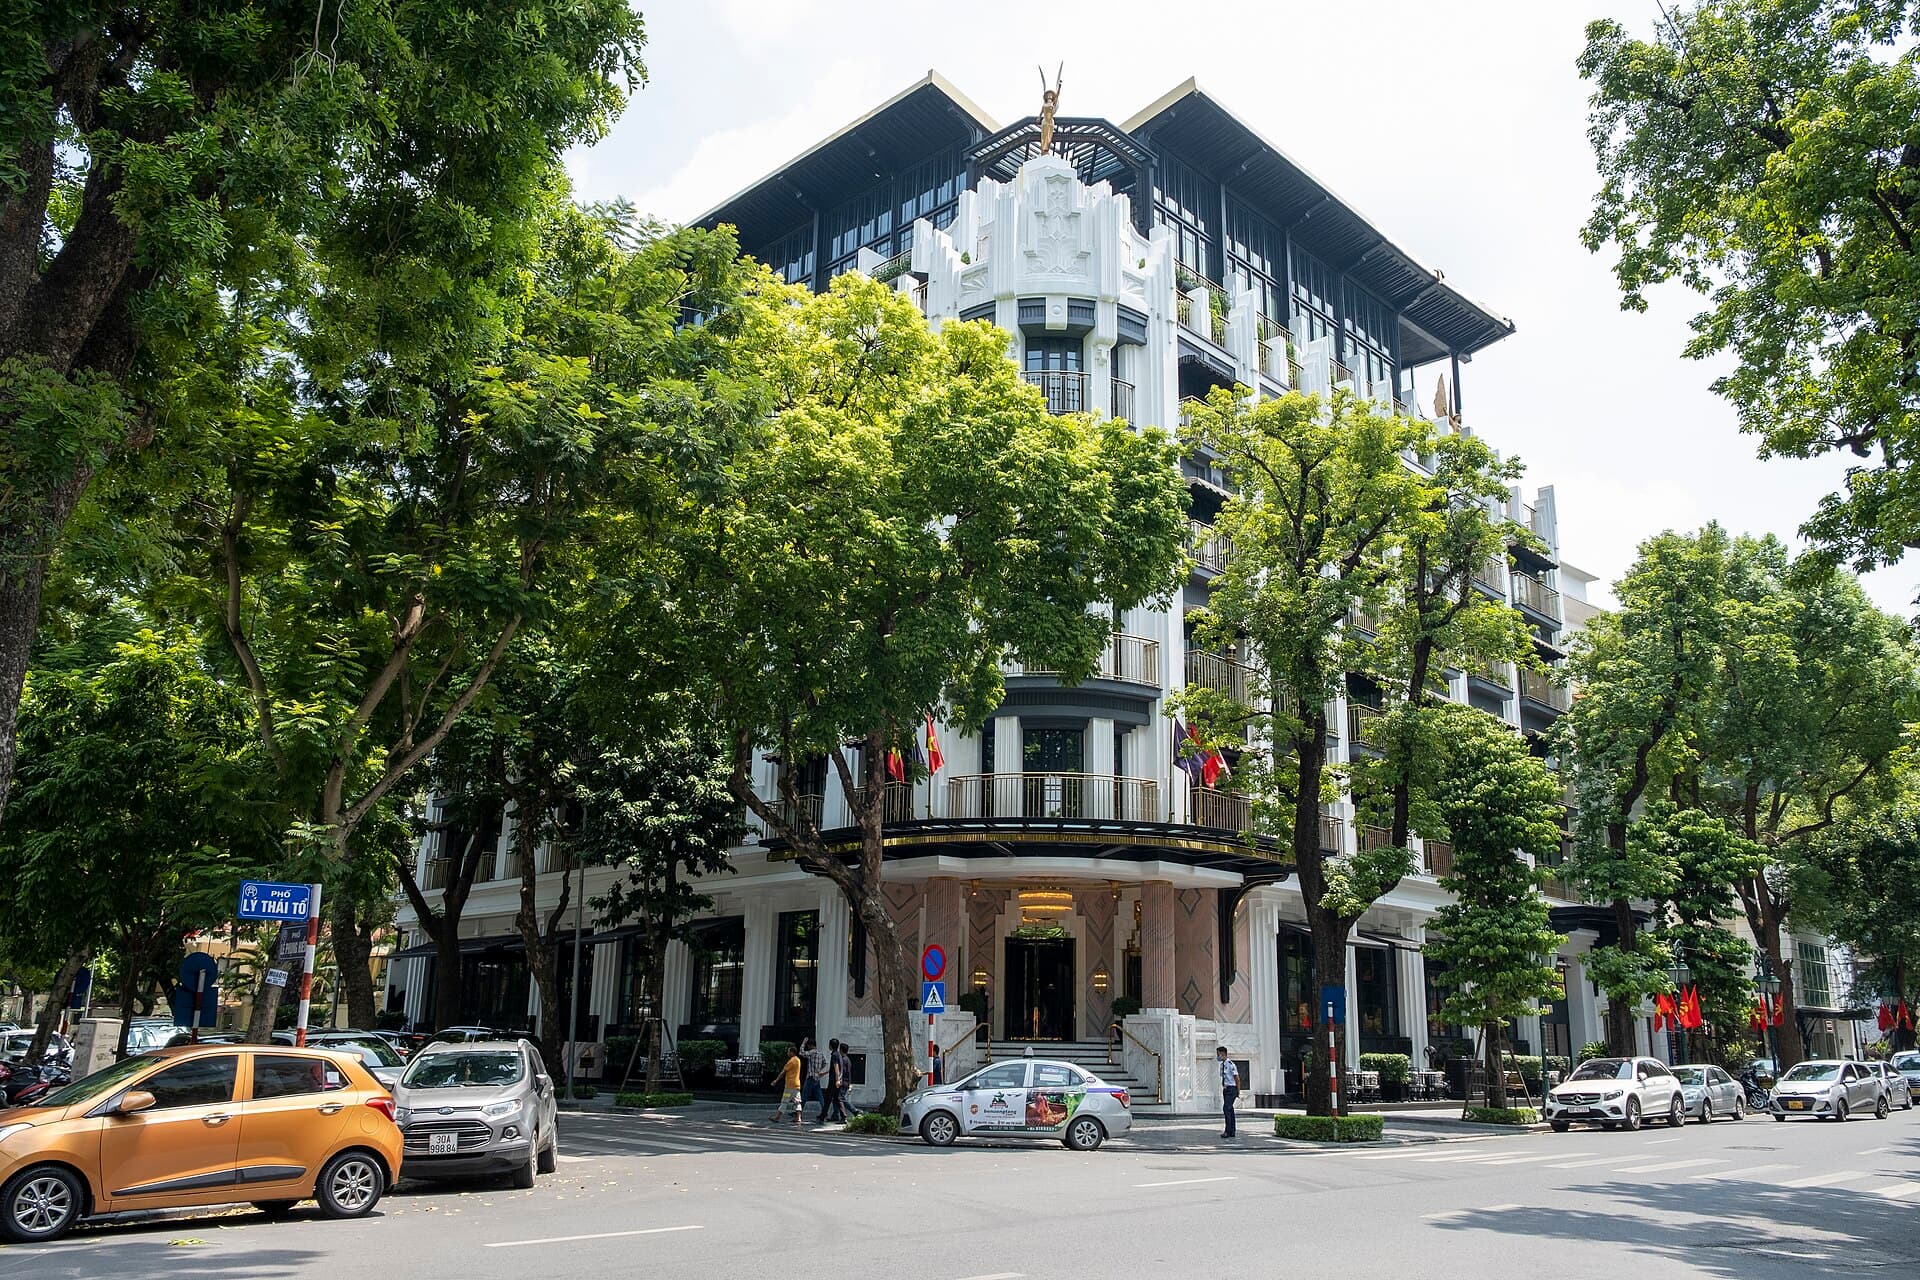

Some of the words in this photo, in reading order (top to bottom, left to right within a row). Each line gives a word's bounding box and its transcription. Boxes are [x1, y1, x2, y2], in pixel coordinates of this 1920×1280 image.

[271, 889, 291, 898] PHỐ
[243, 897, 258, 912] LÝ
[261, 898, 289, 914] THÁI
[292, 897, 308, 915] TỔ
[436, 1135, 451, 1144] 30A
